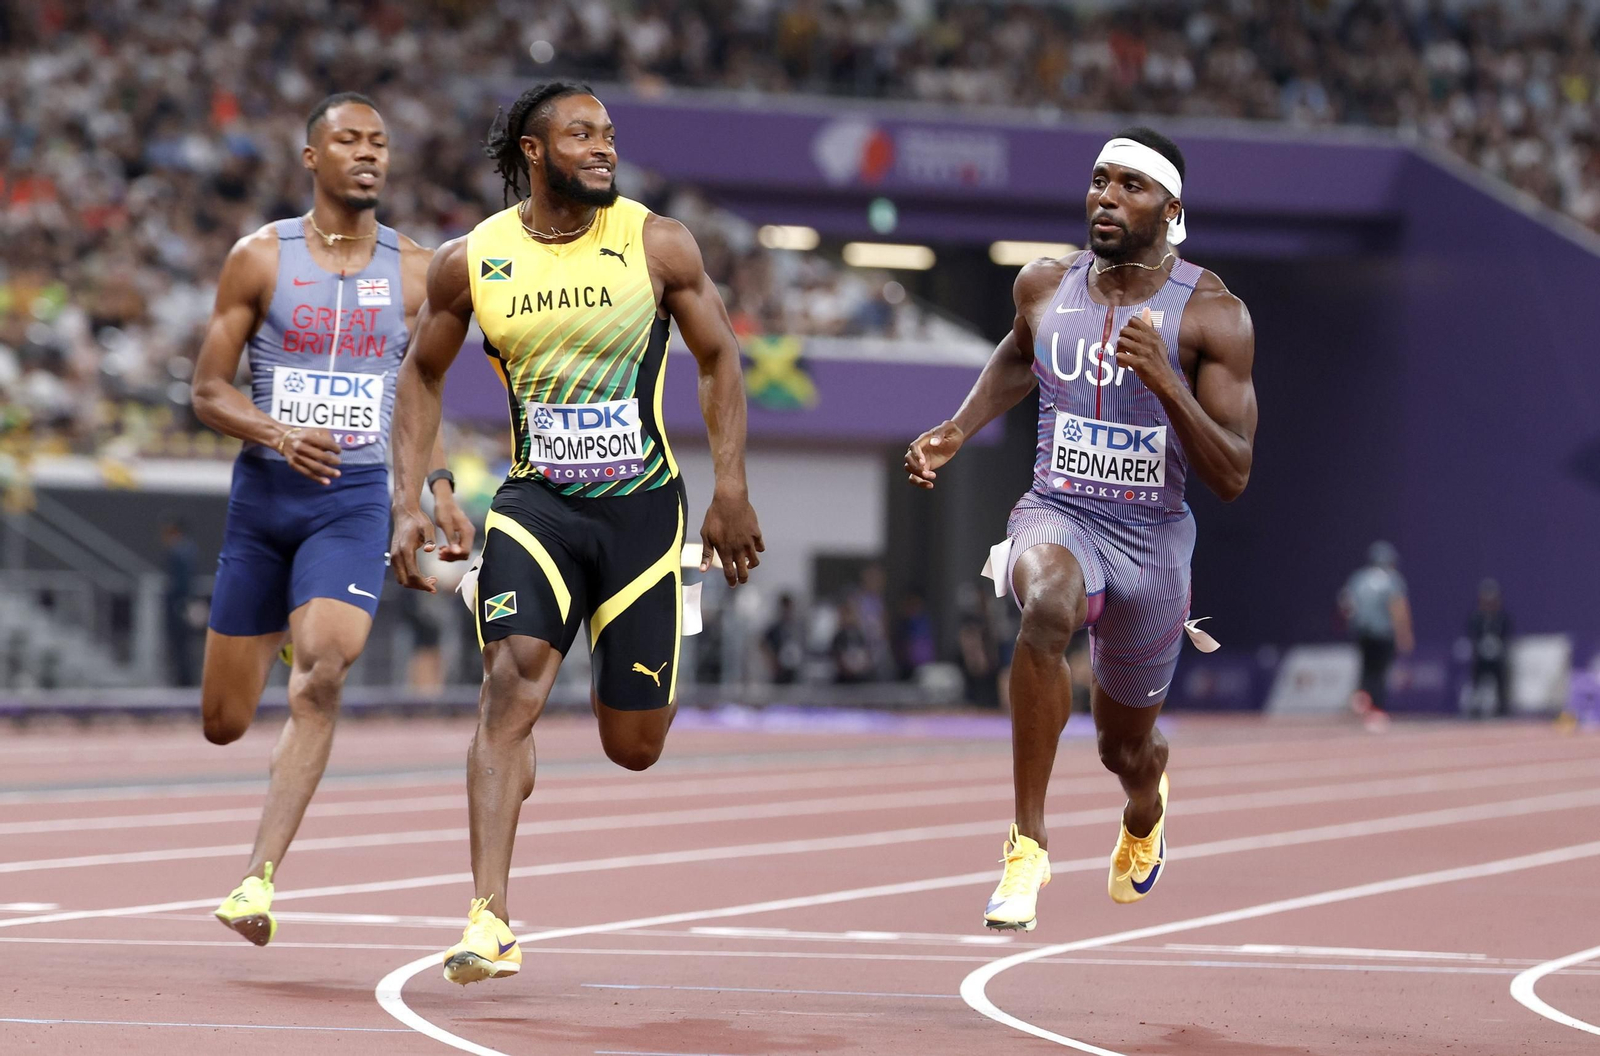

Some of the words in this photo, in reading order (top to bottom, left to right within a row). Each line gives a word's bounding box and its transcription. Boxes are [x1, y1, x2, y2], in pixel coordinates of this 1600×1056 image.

[506, 286, 613, 318] JAMAICA
[292, 304, 382, 332] GREAT
[282, 330, 387, 358] BRITAIN
[306, 374, 374, 399] TDK
[278, 399, 373, 429] HUGHES
[552, 404, 630, 430] TDK
[533, 431, 637, 461] THOMPSON
[1083, 421, 1159, 454] TDK
[1056, 445, 1161, 484] BEDNAREK
